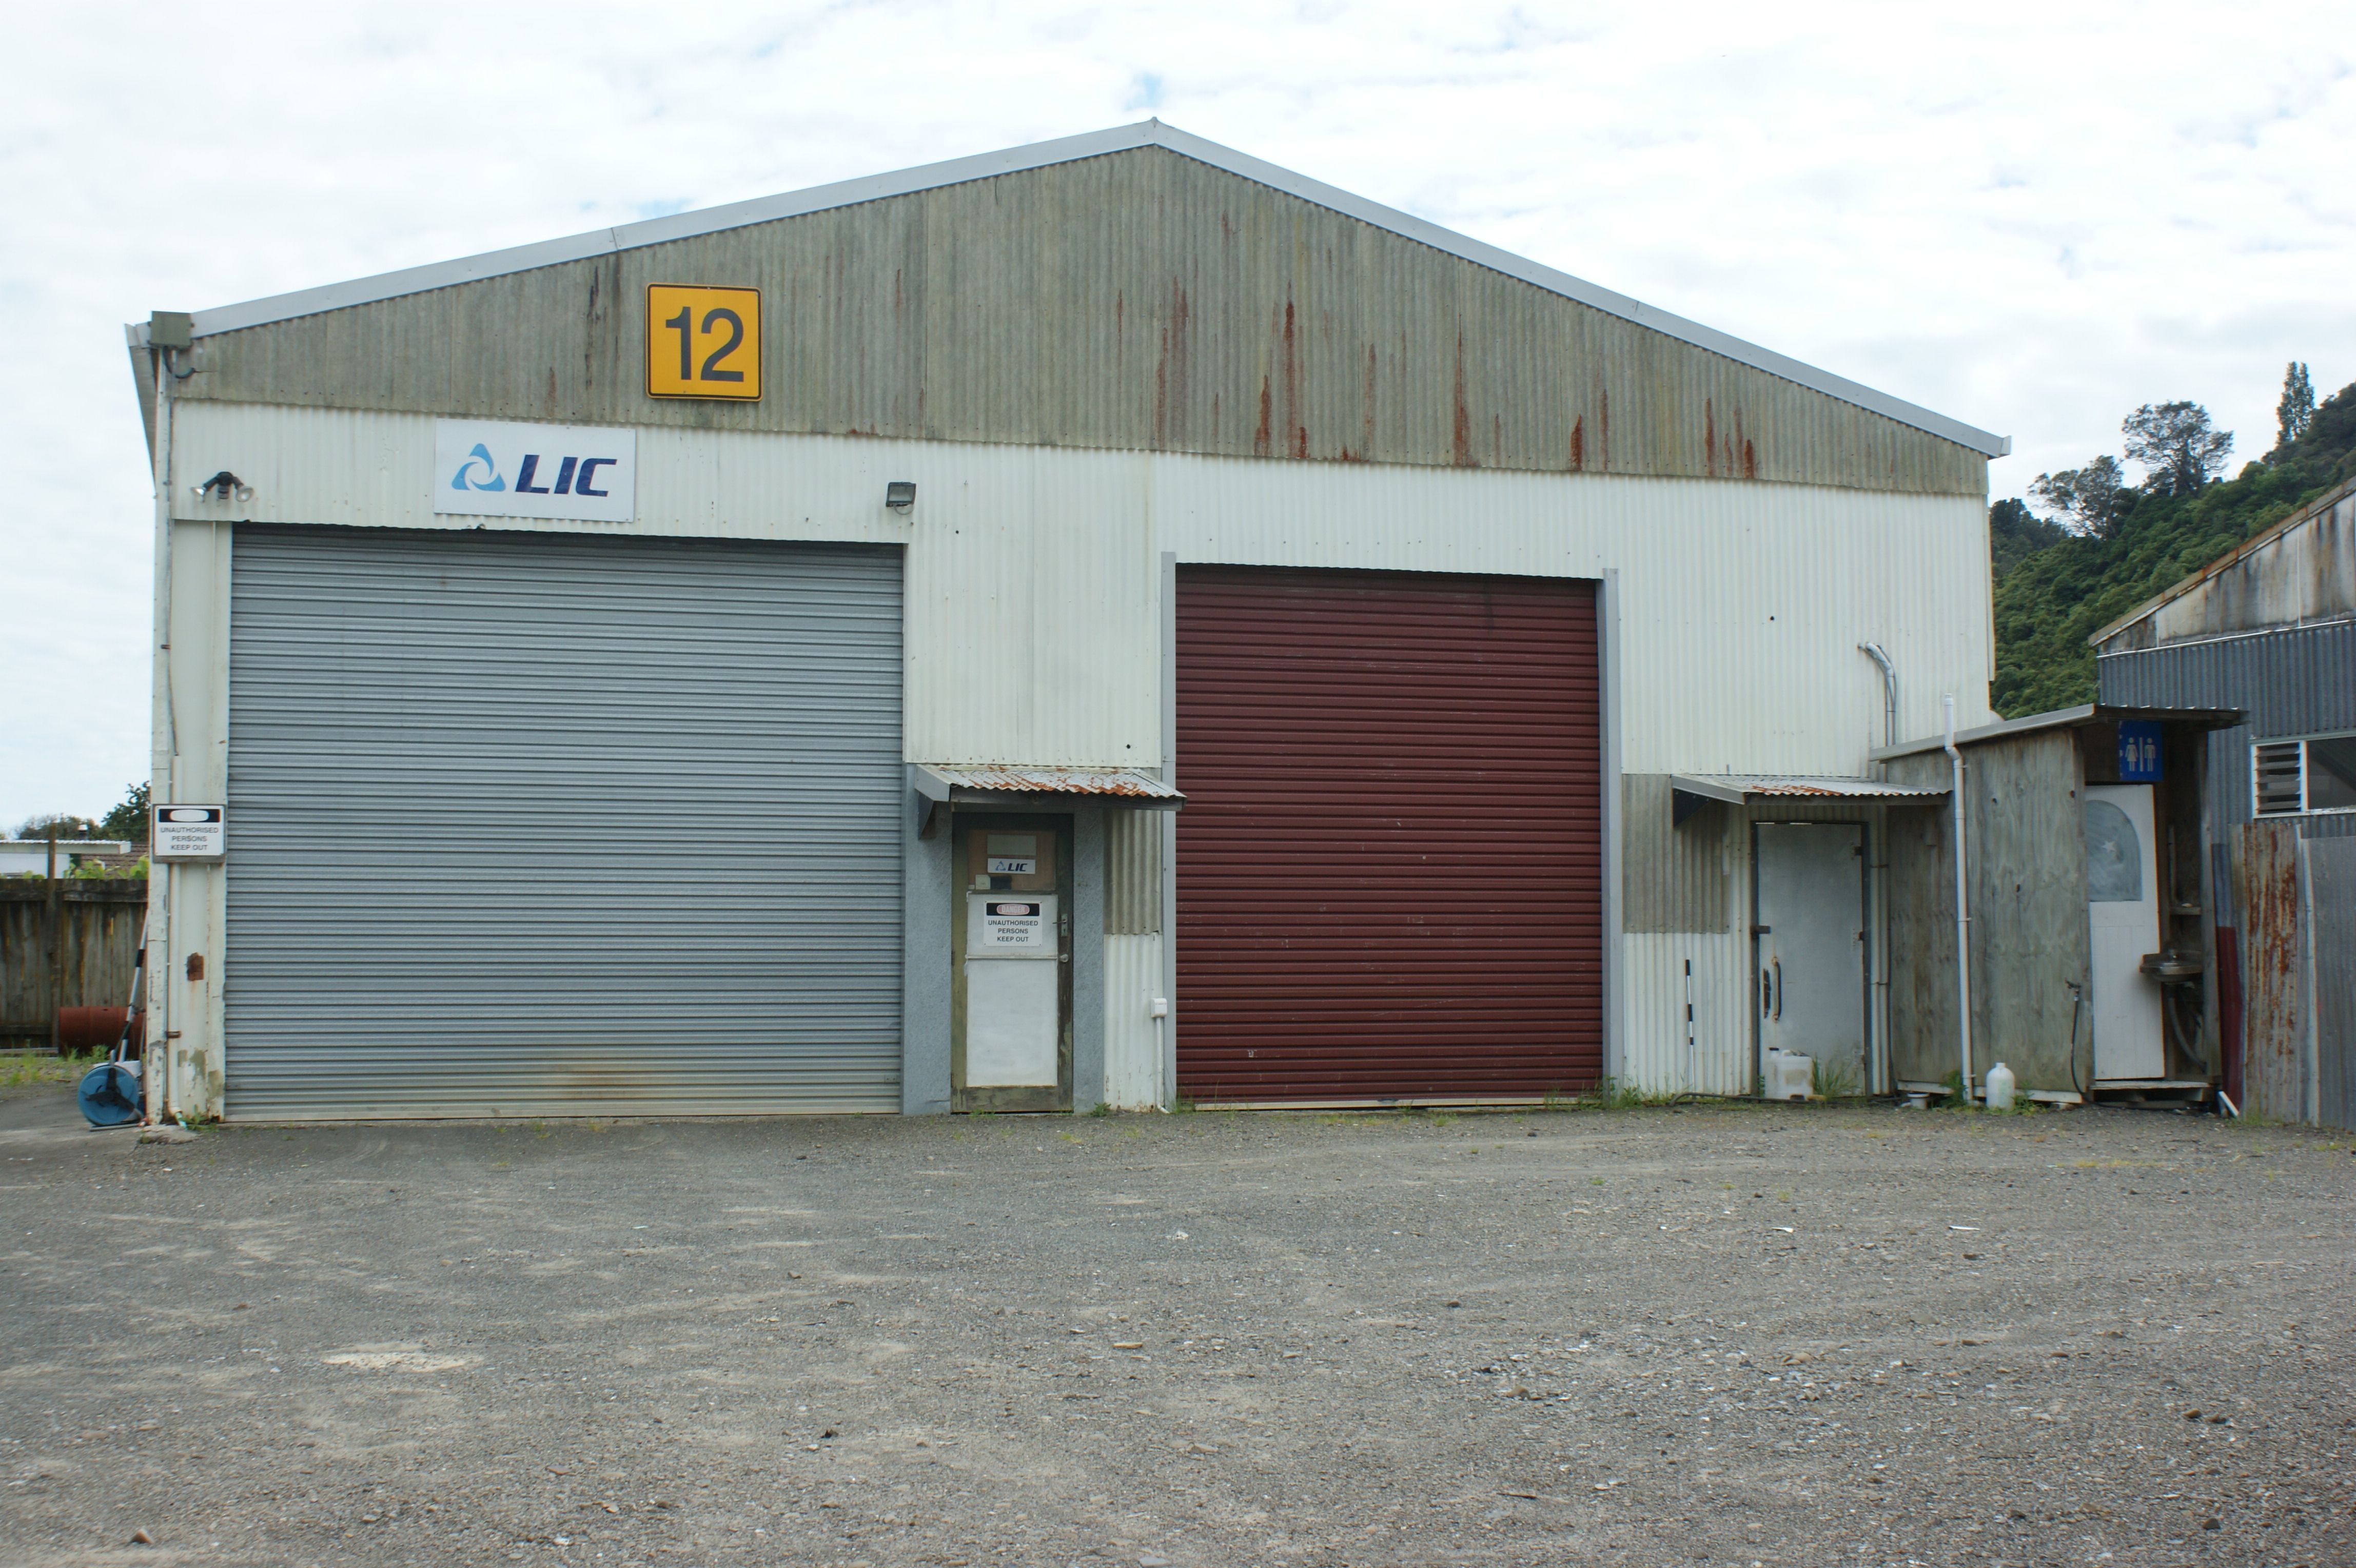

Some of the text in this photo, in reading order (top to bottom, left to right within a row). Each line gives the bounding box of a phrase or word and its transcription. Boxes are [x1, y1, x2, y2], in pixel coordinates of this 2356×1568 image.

[665, 306, 744, 382] 12
[515, 454, 618, 497] LIC
[1008, 863, 1028, 872] LIC
